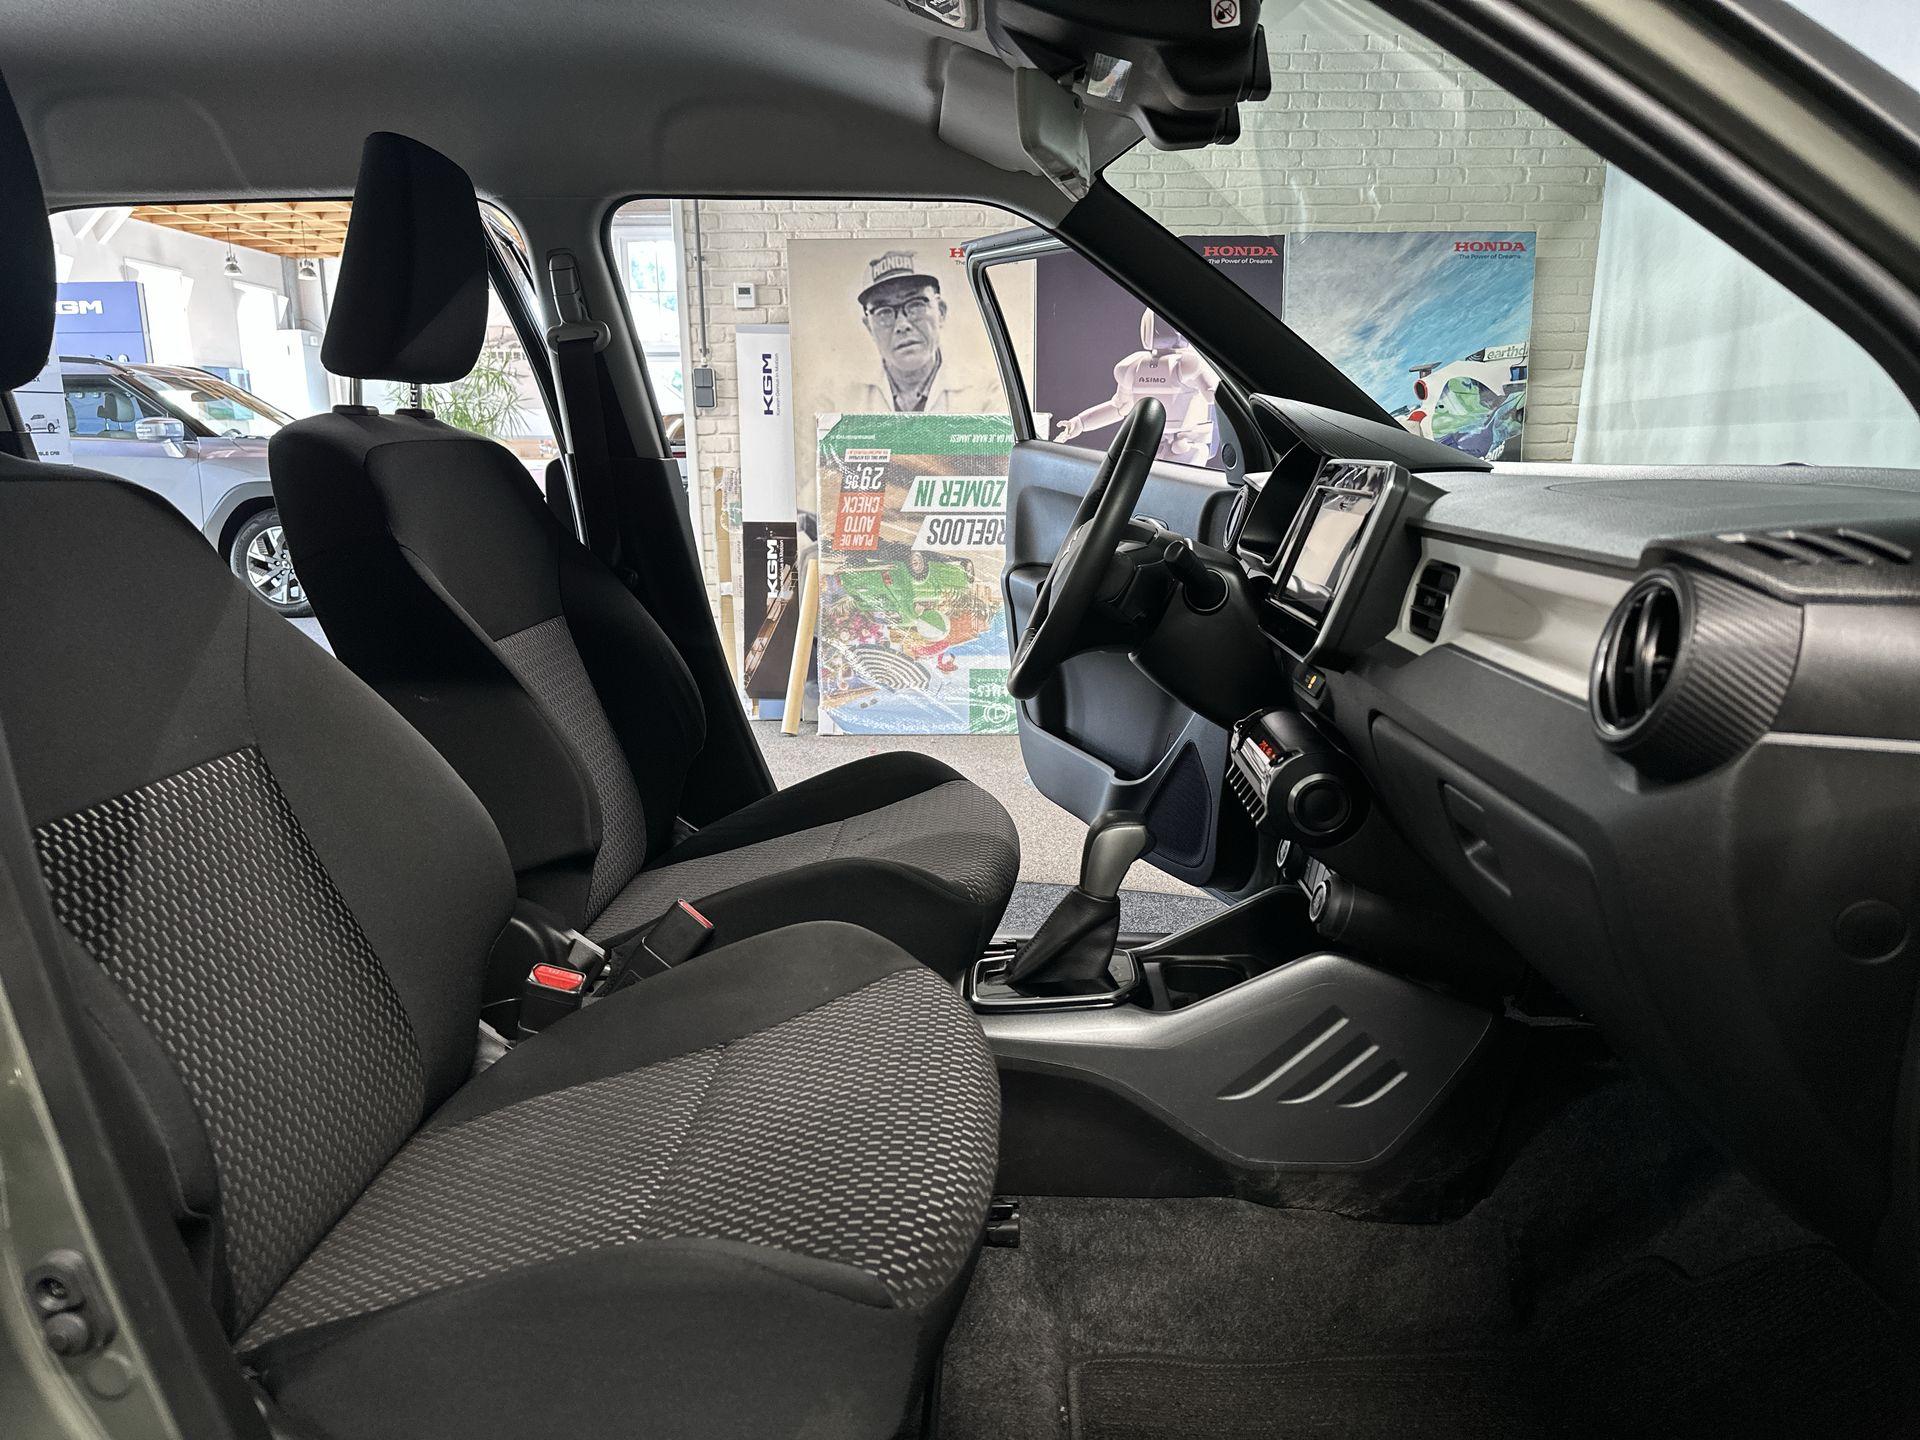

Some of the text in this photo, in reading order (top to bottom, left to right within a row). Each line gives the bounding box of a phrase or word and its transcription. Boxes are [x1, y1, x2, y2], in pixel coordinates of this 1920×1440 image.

[1203, 246, 1279, 257] HONDA
[1454, 241, 1527, 252] HONDA
[762, 353, 774, 416] KGM
[1138, 376, 1167, 384] ASIMO
[914, 480, 1006, 507] ZOMER IN
[841, 496, 880, 513] CHECK
[844, 516, 876, 532] AUTO
[840, 534, 874, 547] PLAN DE
[767, 539, 778, 599] KGM
